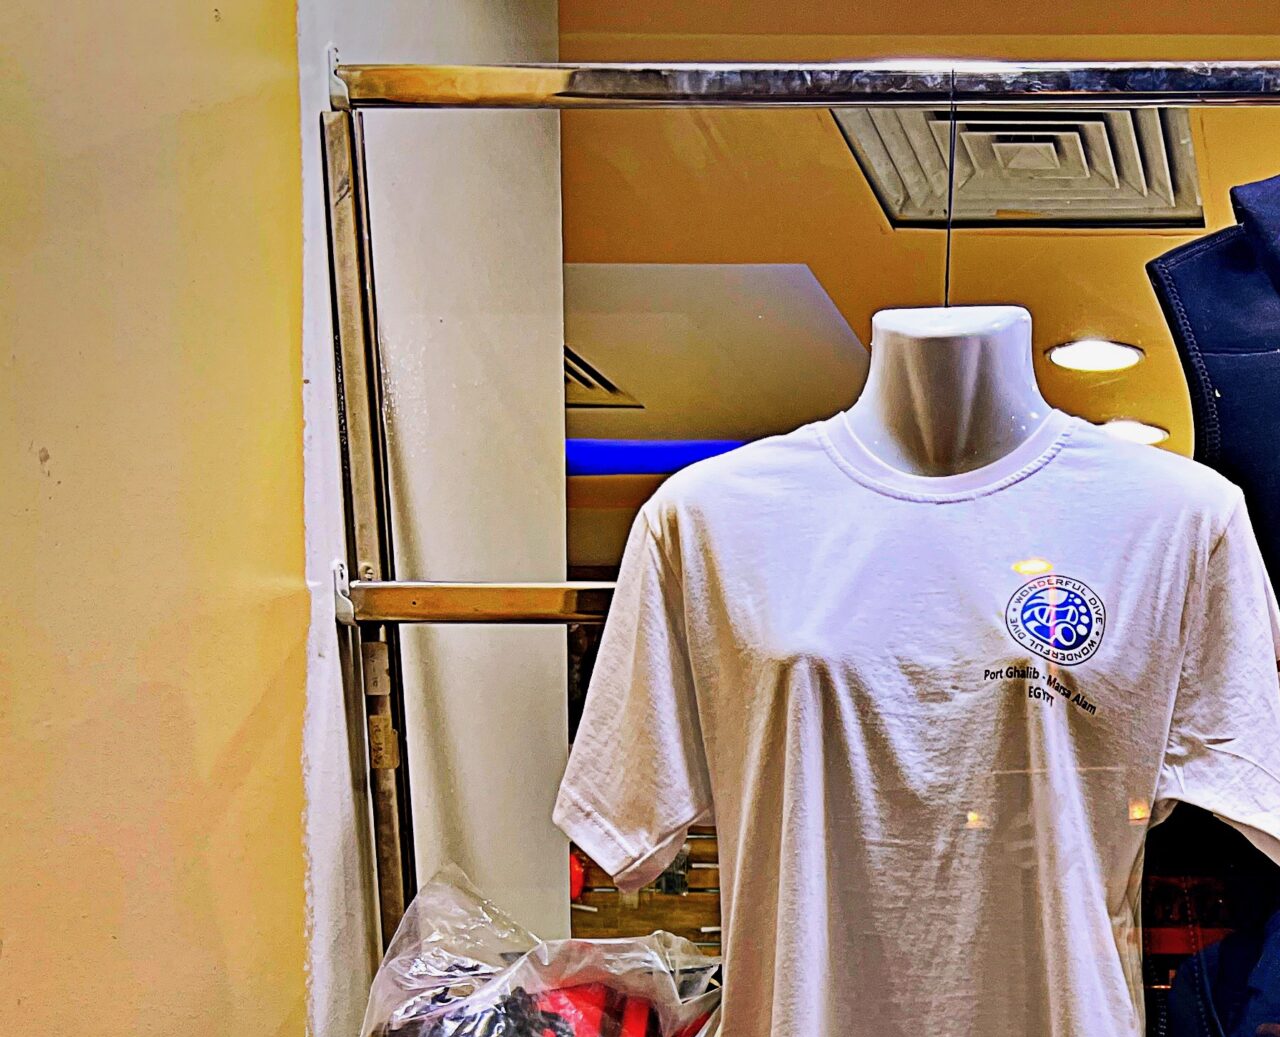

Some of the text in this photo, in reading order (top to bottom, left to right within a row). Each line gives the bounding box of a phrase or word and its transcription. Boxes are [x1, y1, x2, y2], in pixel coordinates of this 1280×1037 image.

[1014, 578, 1103, 625] WONDERFUL DIVE
[1010, 617, 1098, 661] WONDERFUL DIVE
[983, 668, 1003, 680] Port
[1005, 666, 1040, 679] Ghalib
[1046, 675, 1072, 699] Marsa
[1071, 693, 1097, 715] Alam
